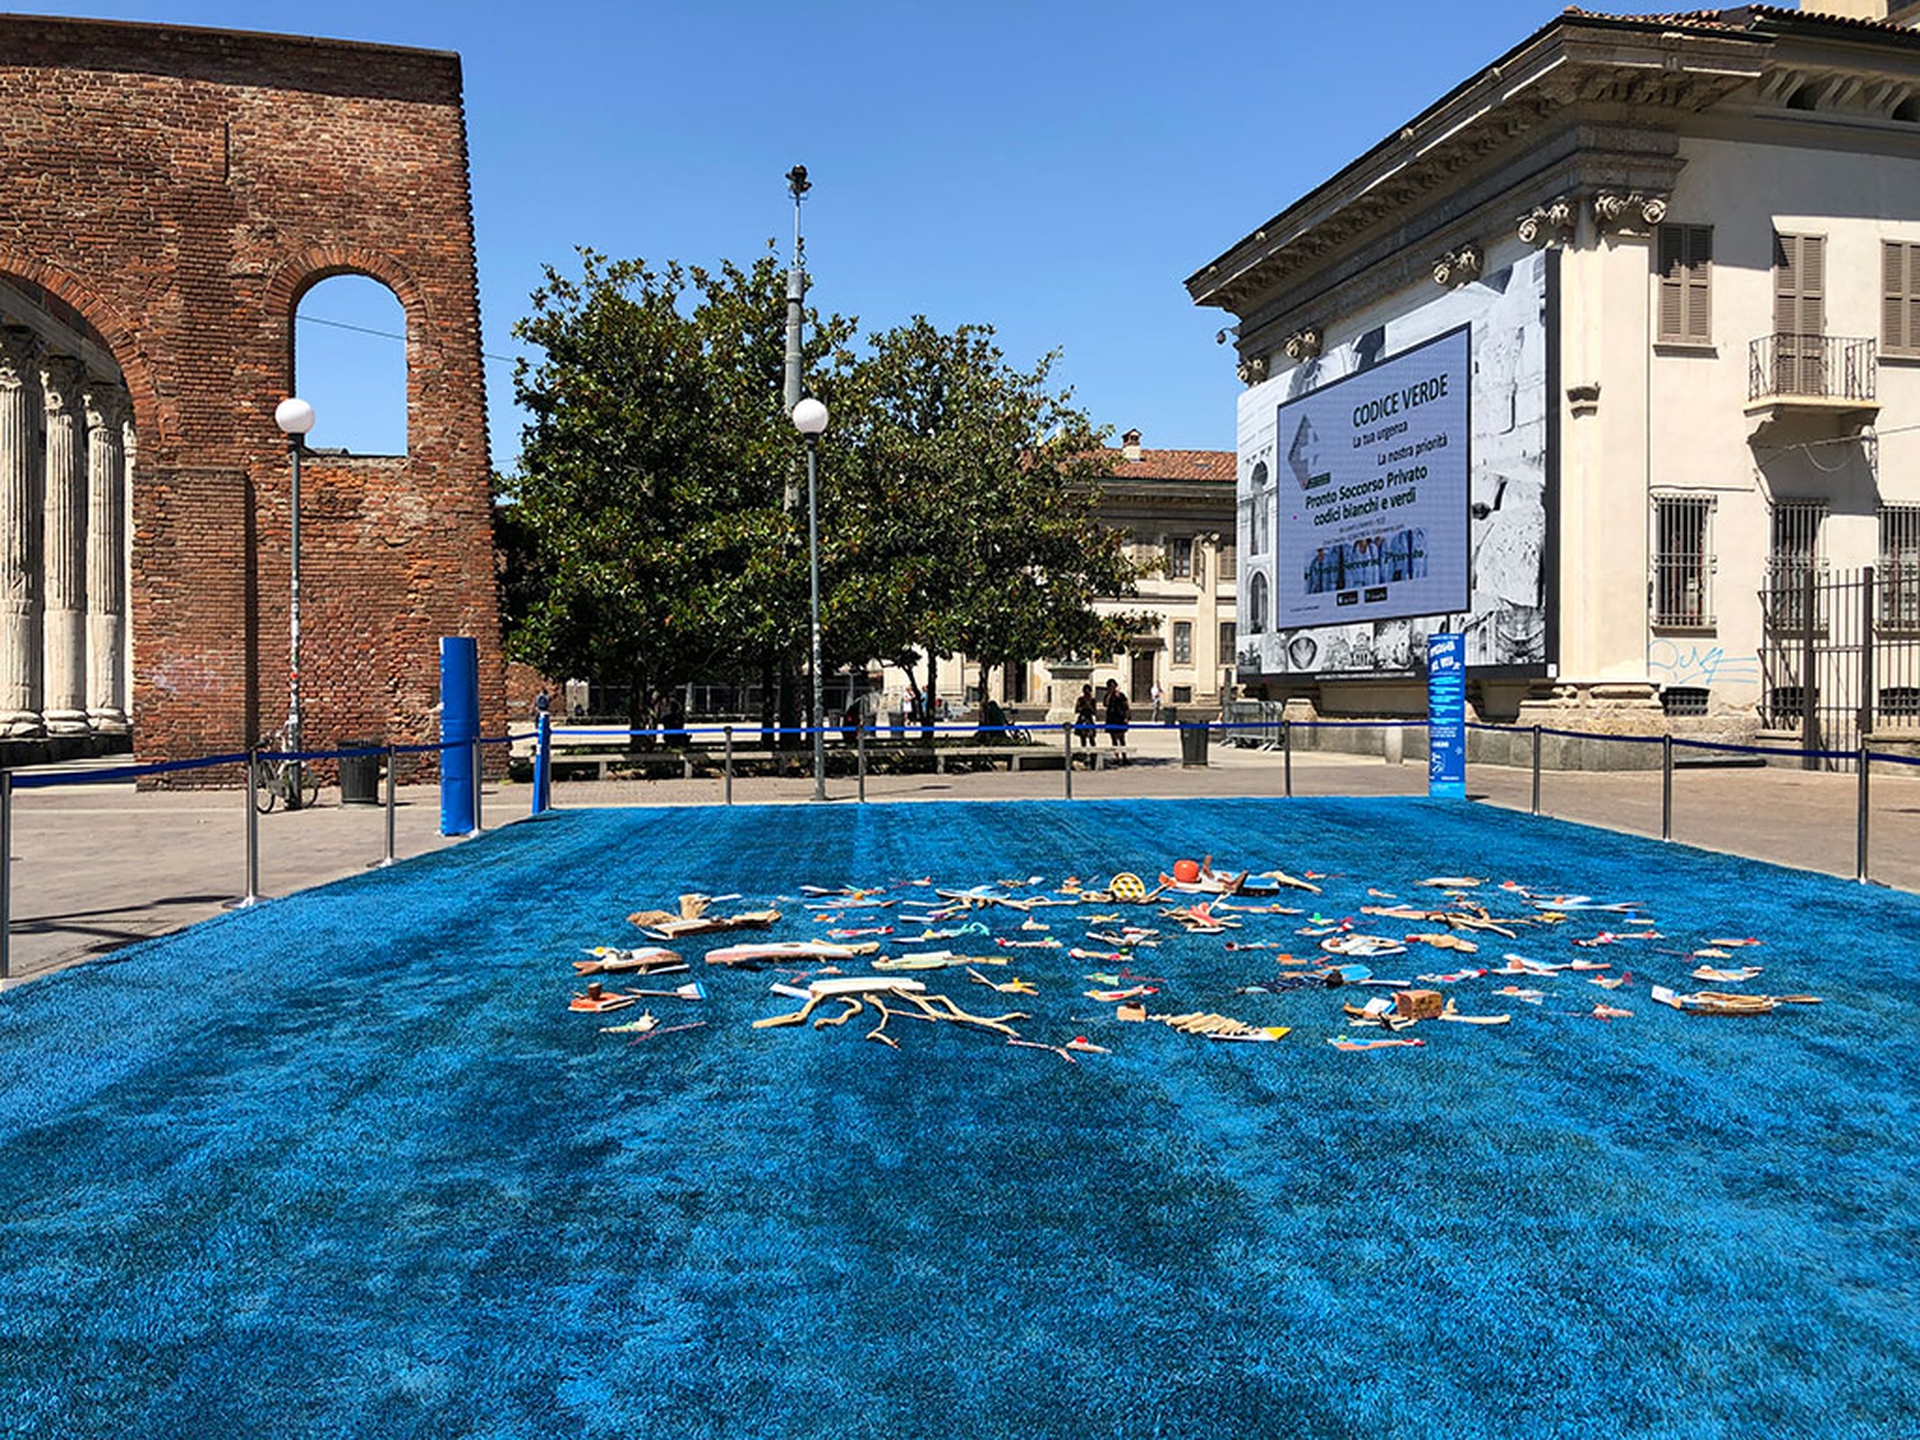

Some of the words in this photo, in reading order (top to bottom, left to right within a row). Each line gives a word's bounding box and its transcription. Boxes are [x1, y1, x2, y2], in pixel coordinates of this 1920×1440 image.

[1353, 394, 1399, 427] CODICE
[1402, 373, 1448, 409] VERDE
[1353, 436, 1361, 448] La
[1363, 432, 1375, 445] tua
[1377, 421, 1408, 441] urgenza
[1378, 453, 1386, 465] La
[1388, 445, 1414, 463] nostra
[1416, 432, 1448, 458] priorità
[1305, 491, 1337, 510] Pronto
[1339, 478, 1384, 501] Soccorso
[1387, 466, 1427, 488] Privato
[1314, 506, 1340, 526] codici
[1343, 496, 1379, 519] bianchi
[1382, 497, 1388, 510] e
[1391, 487, 1416, 508] verdi
